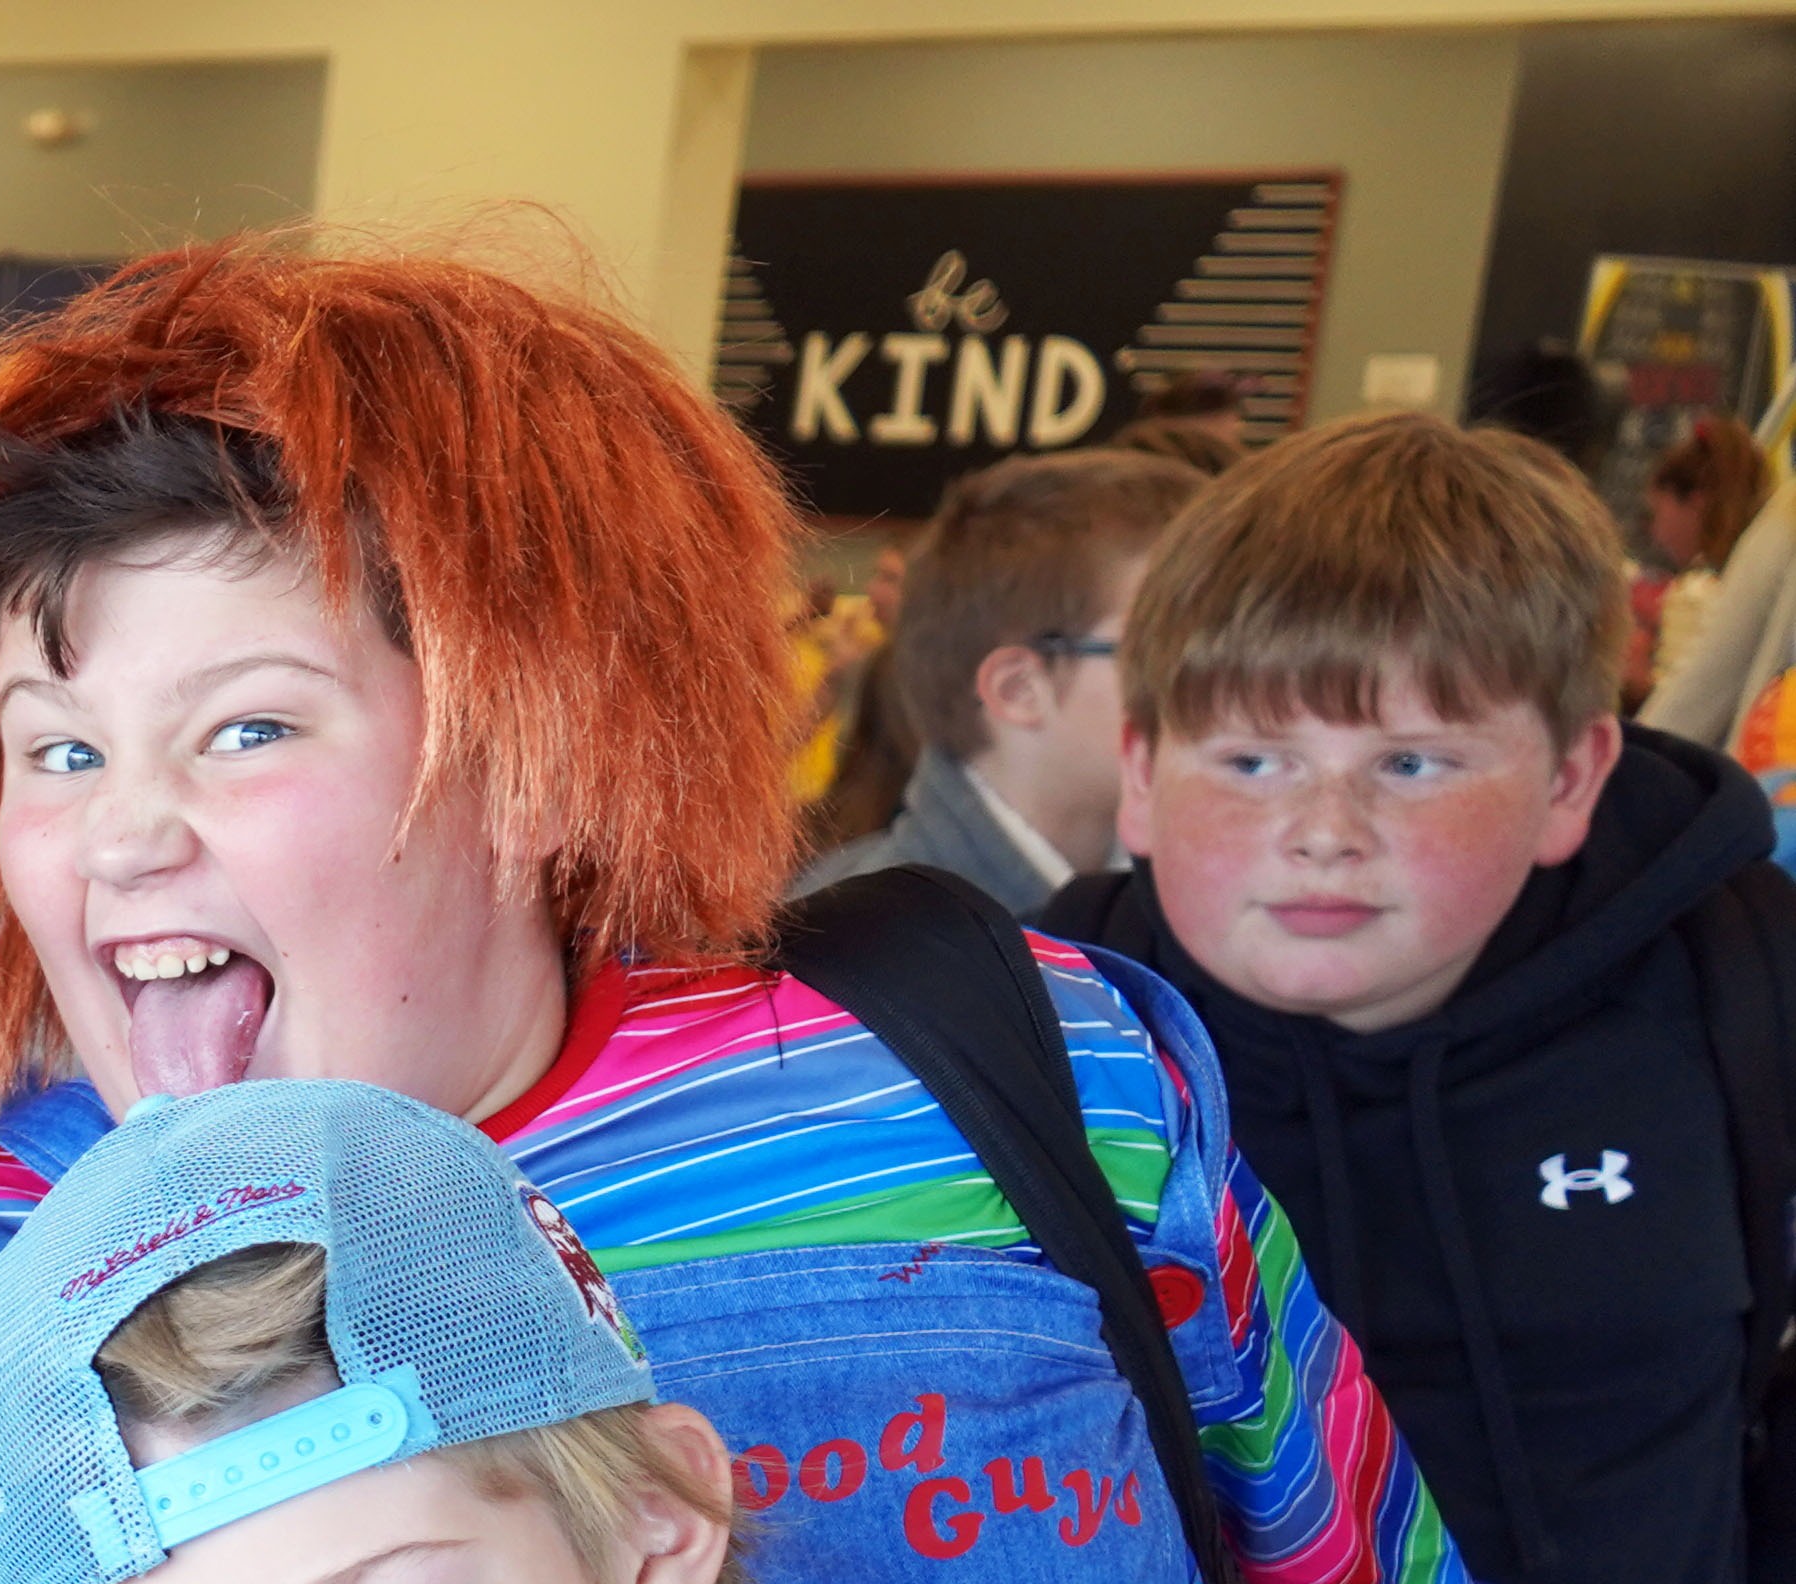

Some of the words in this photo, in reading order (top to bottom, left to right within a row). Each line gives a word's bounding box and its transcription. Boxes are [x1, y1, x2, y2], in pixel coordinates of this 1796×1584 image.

[906, 248, 1010, 333] be
[790, 330, 1107, 447] KIND
[733, 1393, 947, 1510] ood
[903, 1455, 1142, 1560] Guys
